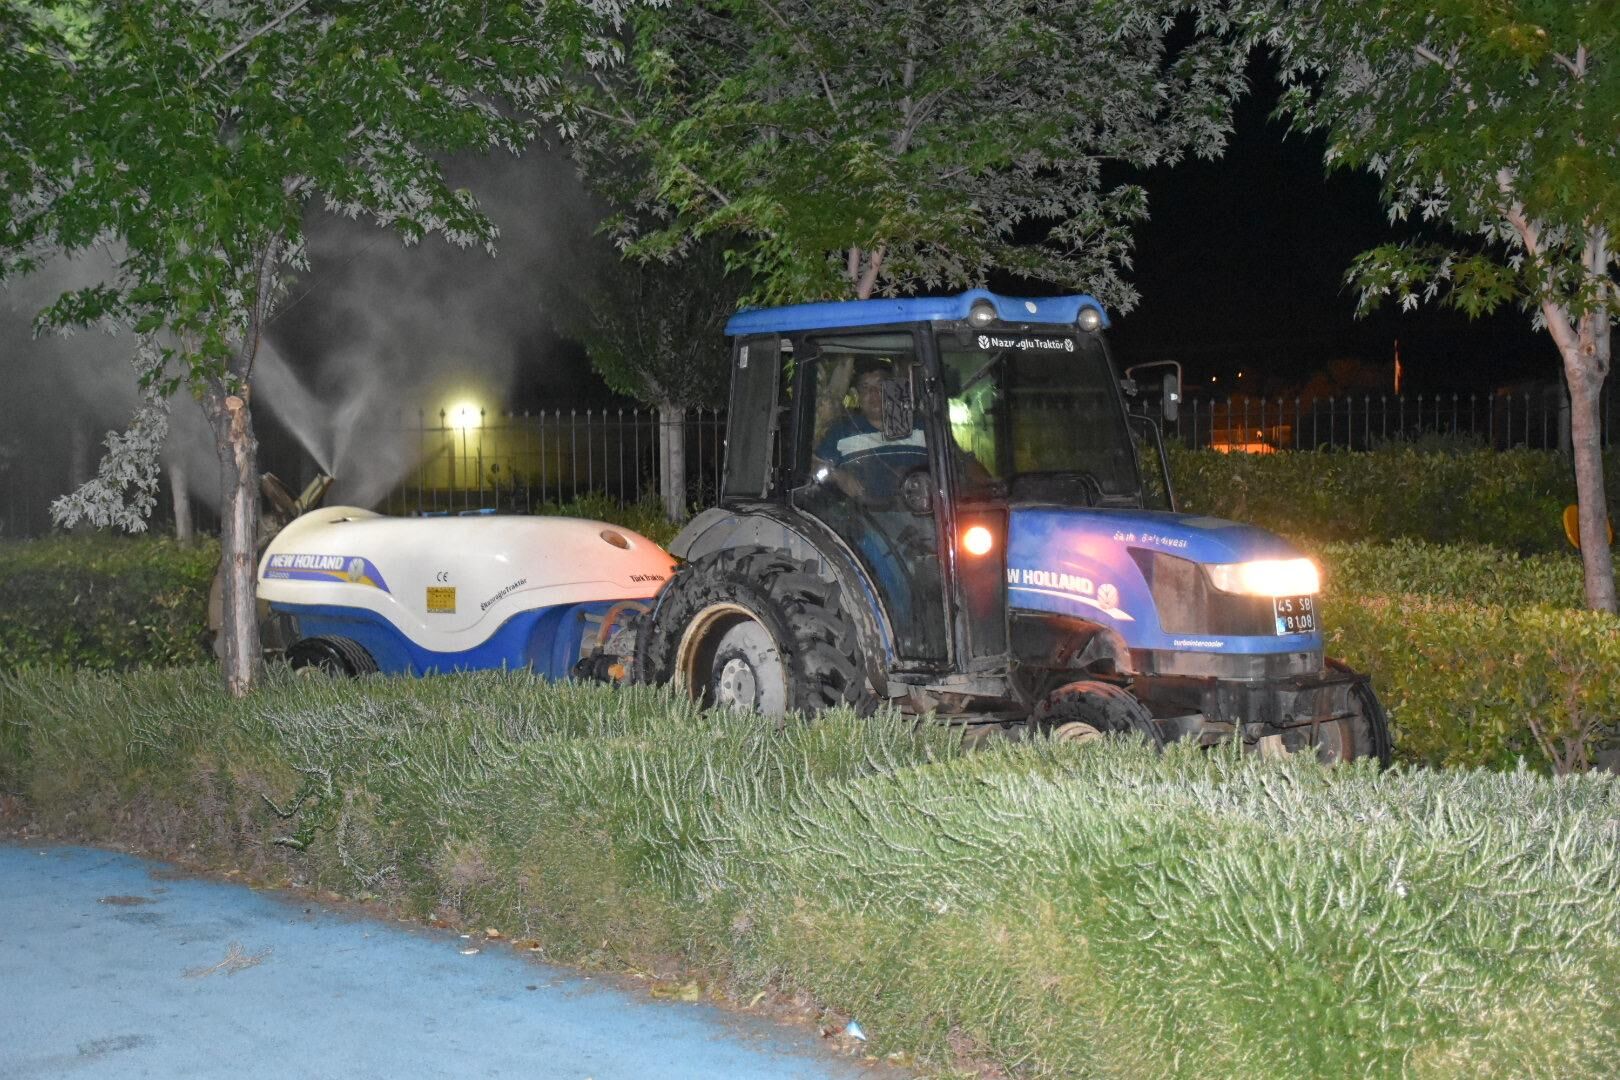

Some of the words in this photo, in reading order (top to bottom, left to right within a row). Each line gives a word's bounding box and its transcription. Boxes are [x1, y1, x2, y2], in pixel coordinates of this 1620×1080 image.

[270, 554, 294, 568] NEW
[294, 555, 344, 571] HOLLAND
[1023, 569, 1095, 595] HOLLAND
[1278, 599, 1292, 612] 45
[1287, 614, 1312, 629] 8108
